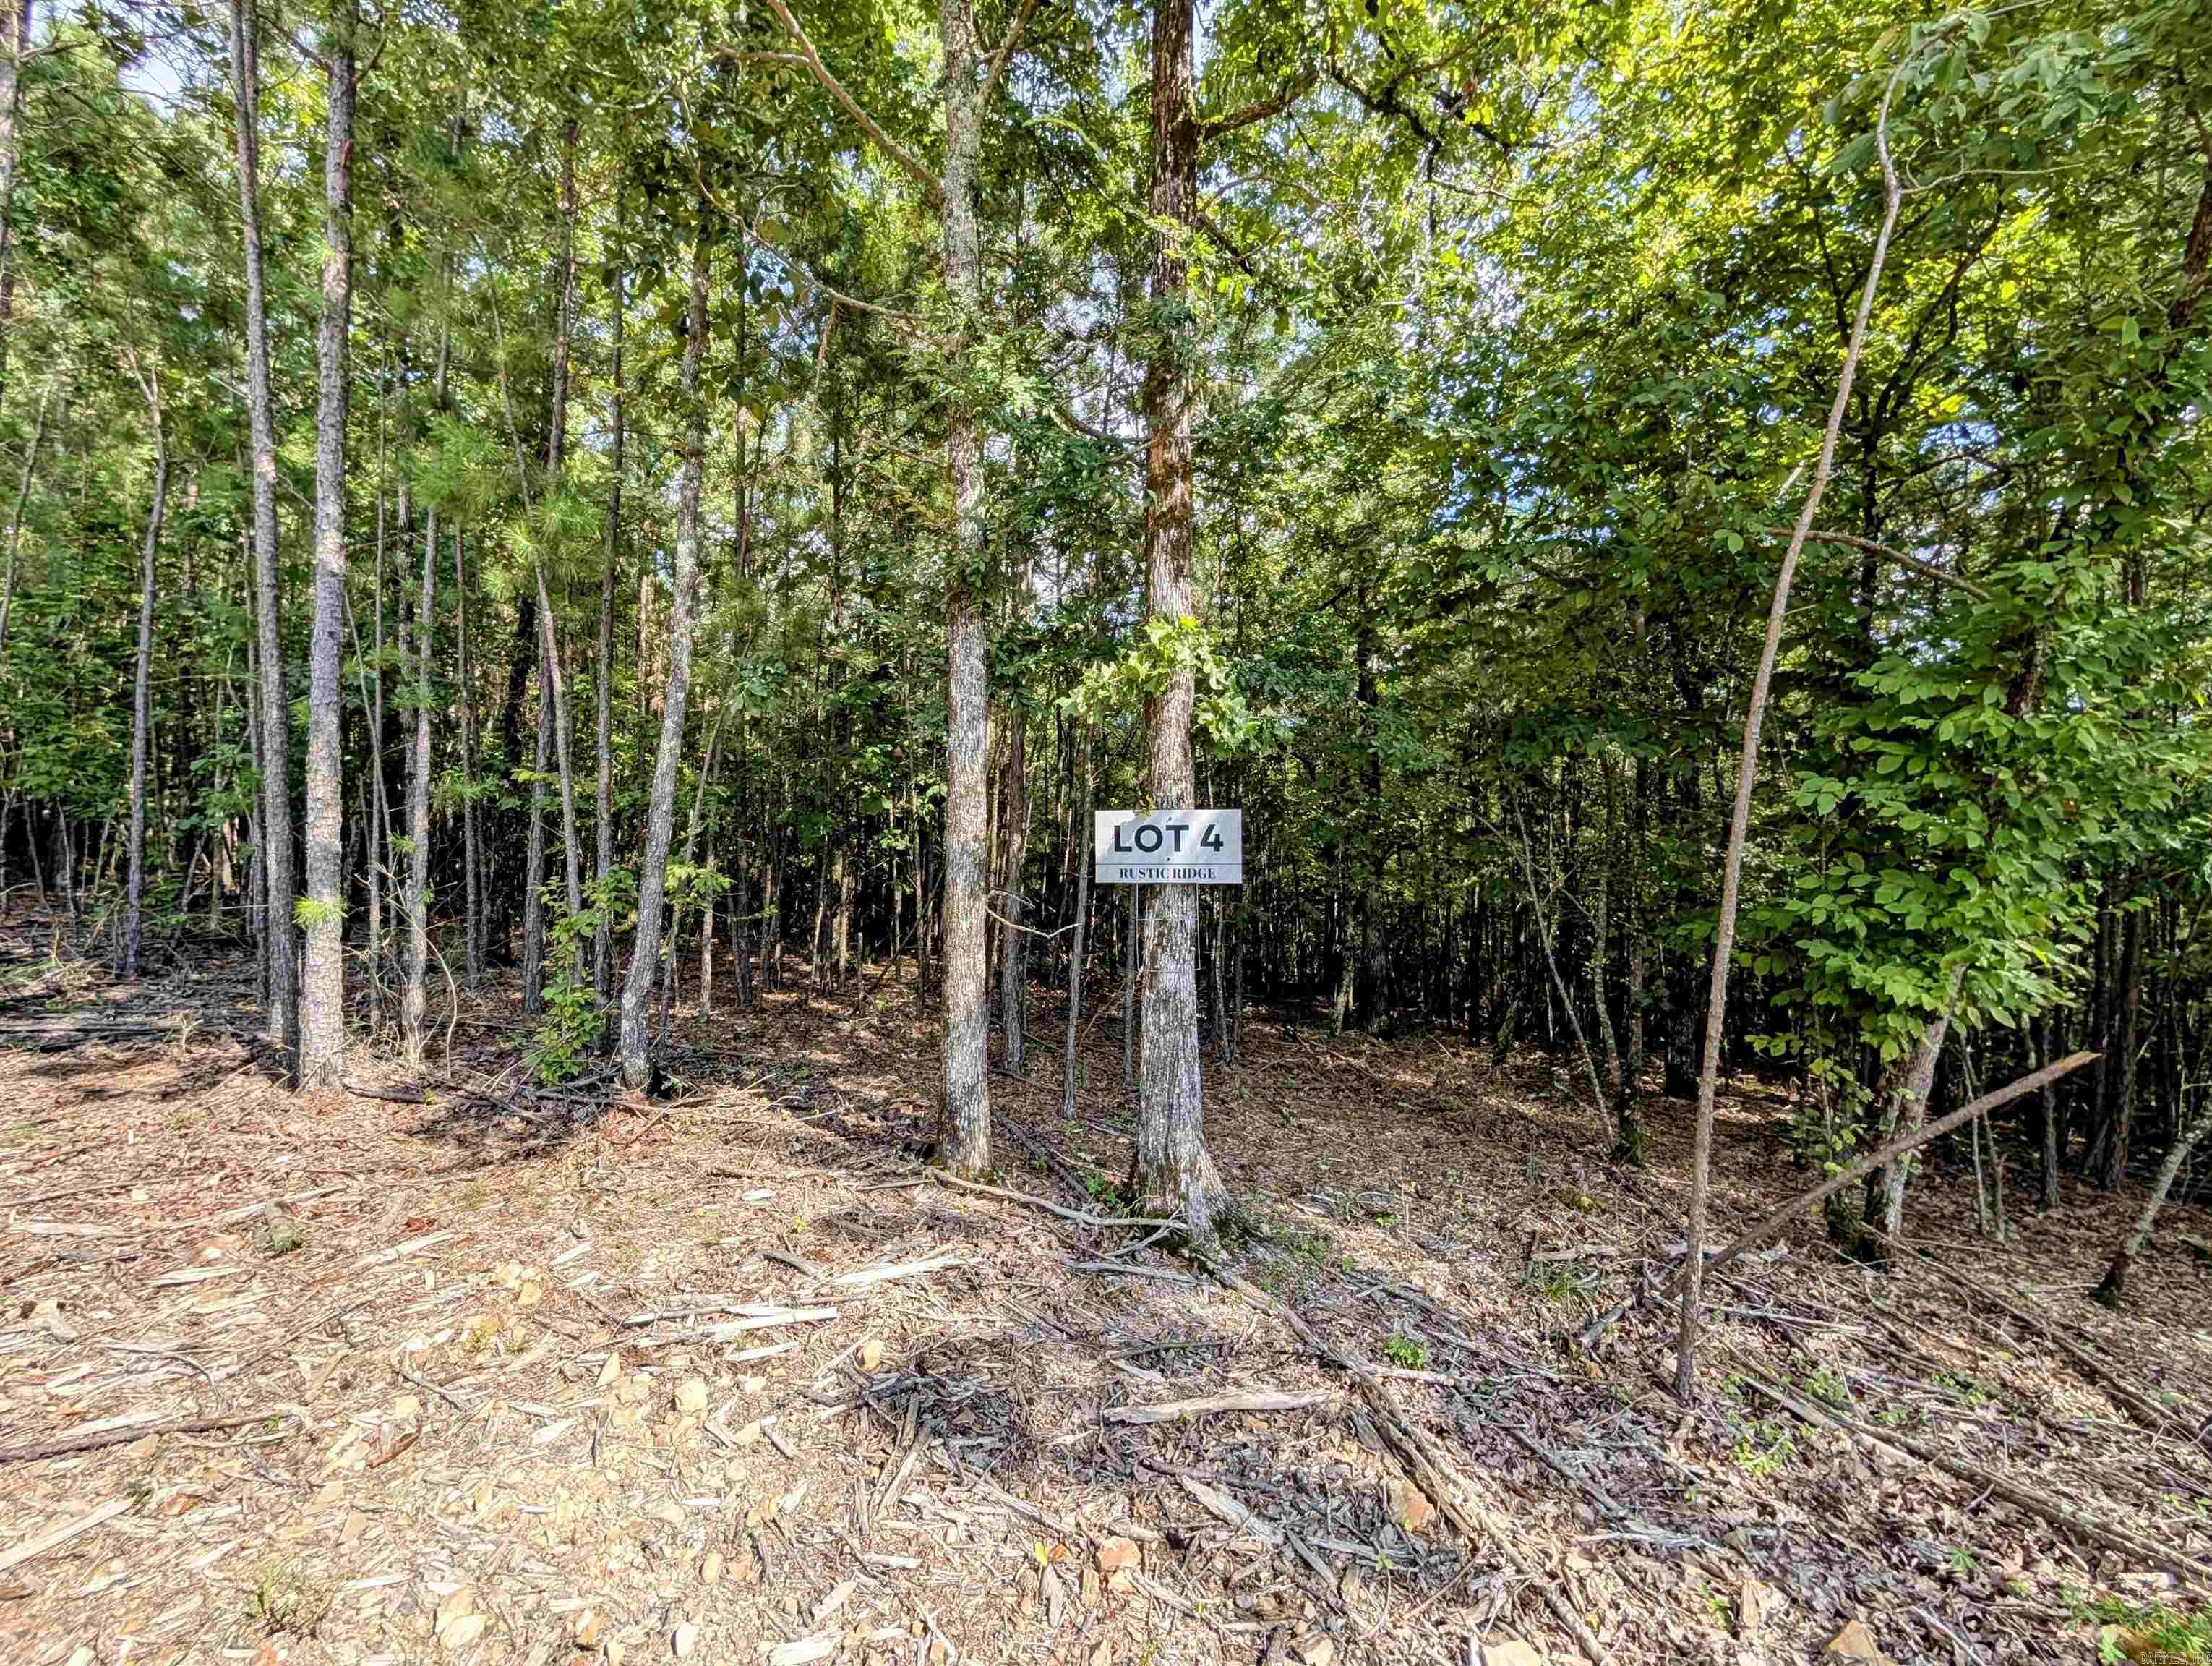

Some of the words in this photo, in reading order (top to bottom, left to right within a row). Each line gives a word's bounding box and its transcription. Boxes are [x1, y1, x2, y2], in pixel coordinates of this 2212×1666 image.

[1114, 824, 1189, 853] LOT
[1200, 824, 1224, 853] 4
[1120, 868, 1169, 879] RUSTIC
[1172, 868, 1216, 879] RIDGE
